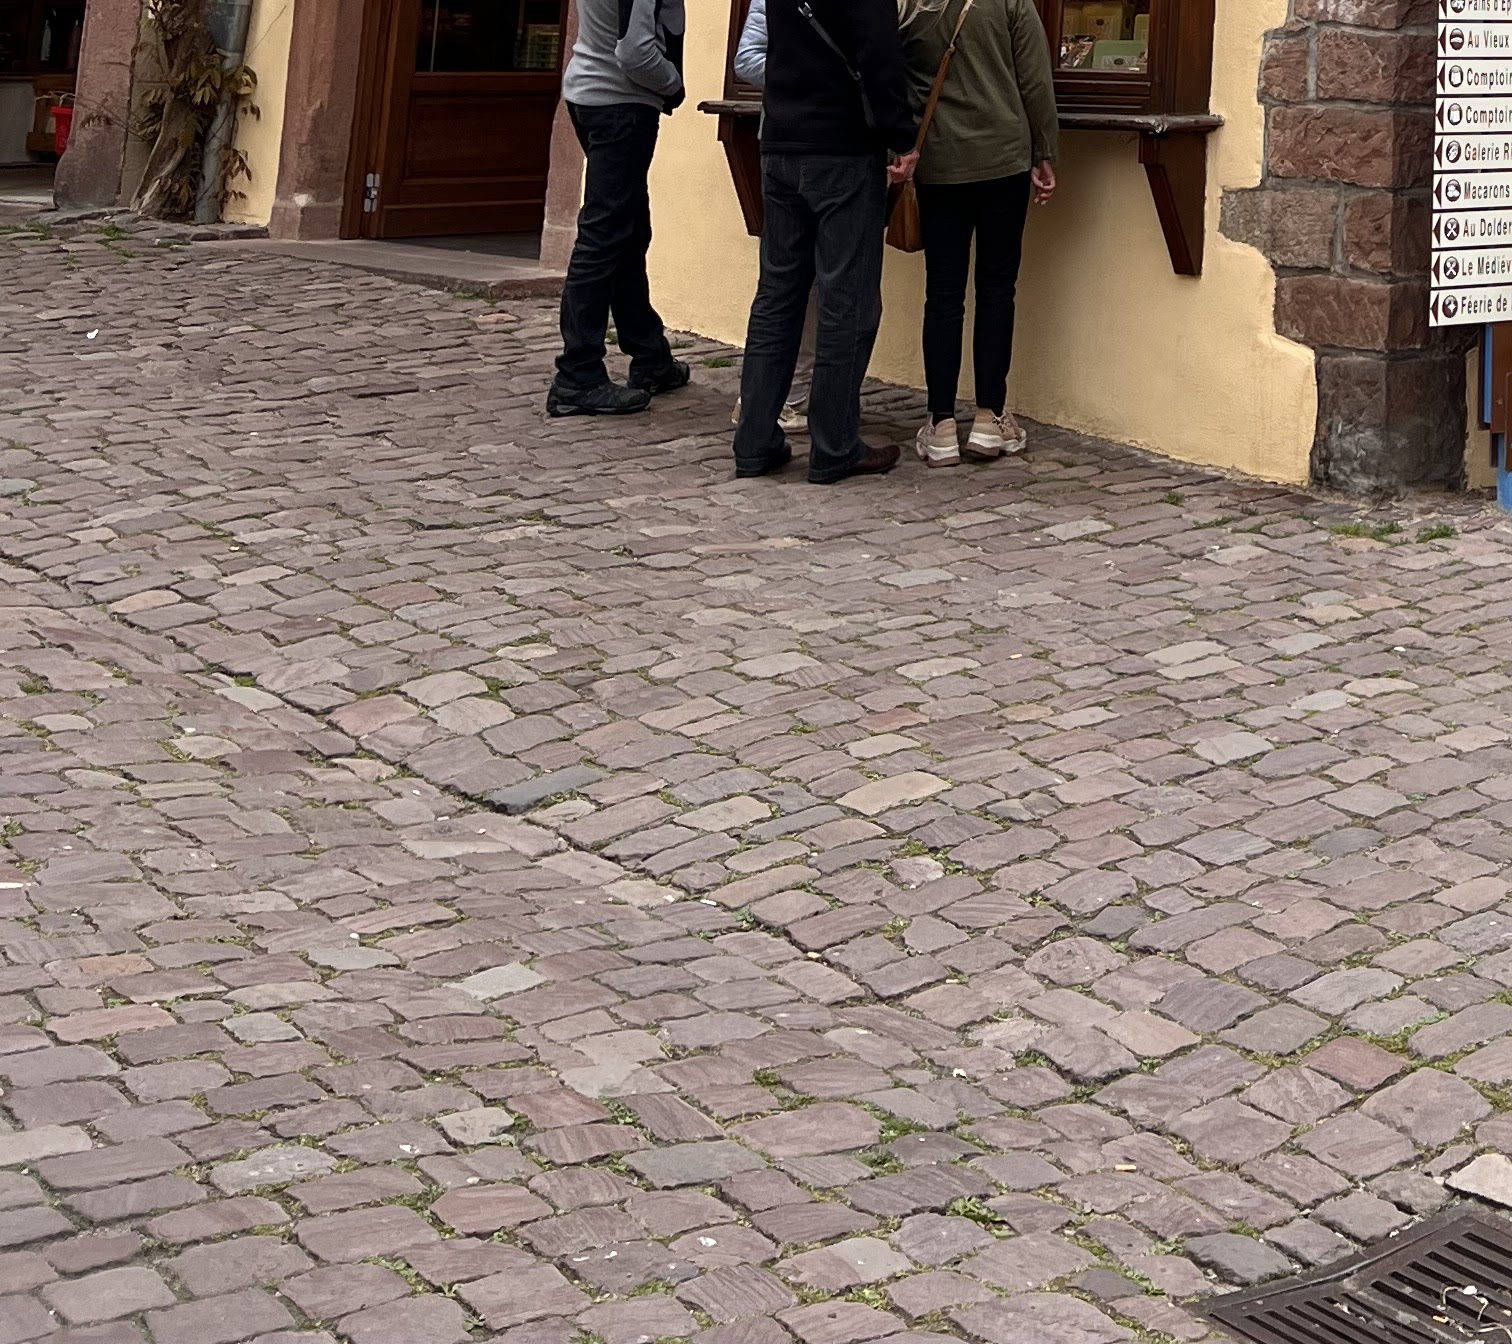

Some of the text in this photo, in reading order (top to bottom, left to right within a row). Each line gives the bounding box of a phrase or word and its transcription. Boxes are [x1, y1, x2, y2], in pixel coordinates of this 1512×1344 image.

[1467, 30, 1479, 48] Au
[1483, 30, 1509, 48] Vieux
[1467, 68, 1512, 90] Comptoir
[1466, 105, 1512, 128] Comptoir
[1465, 143, 1499, 161] Galerie
[1464, 182, 1510, 200] Macarons
[1463, 218, 1512, 237] Au Dolder
[1462, 258, 1473, 276] Le
[1461, 295, 1492, 314] Féerie
[1496, 294, 1507, 312] de
